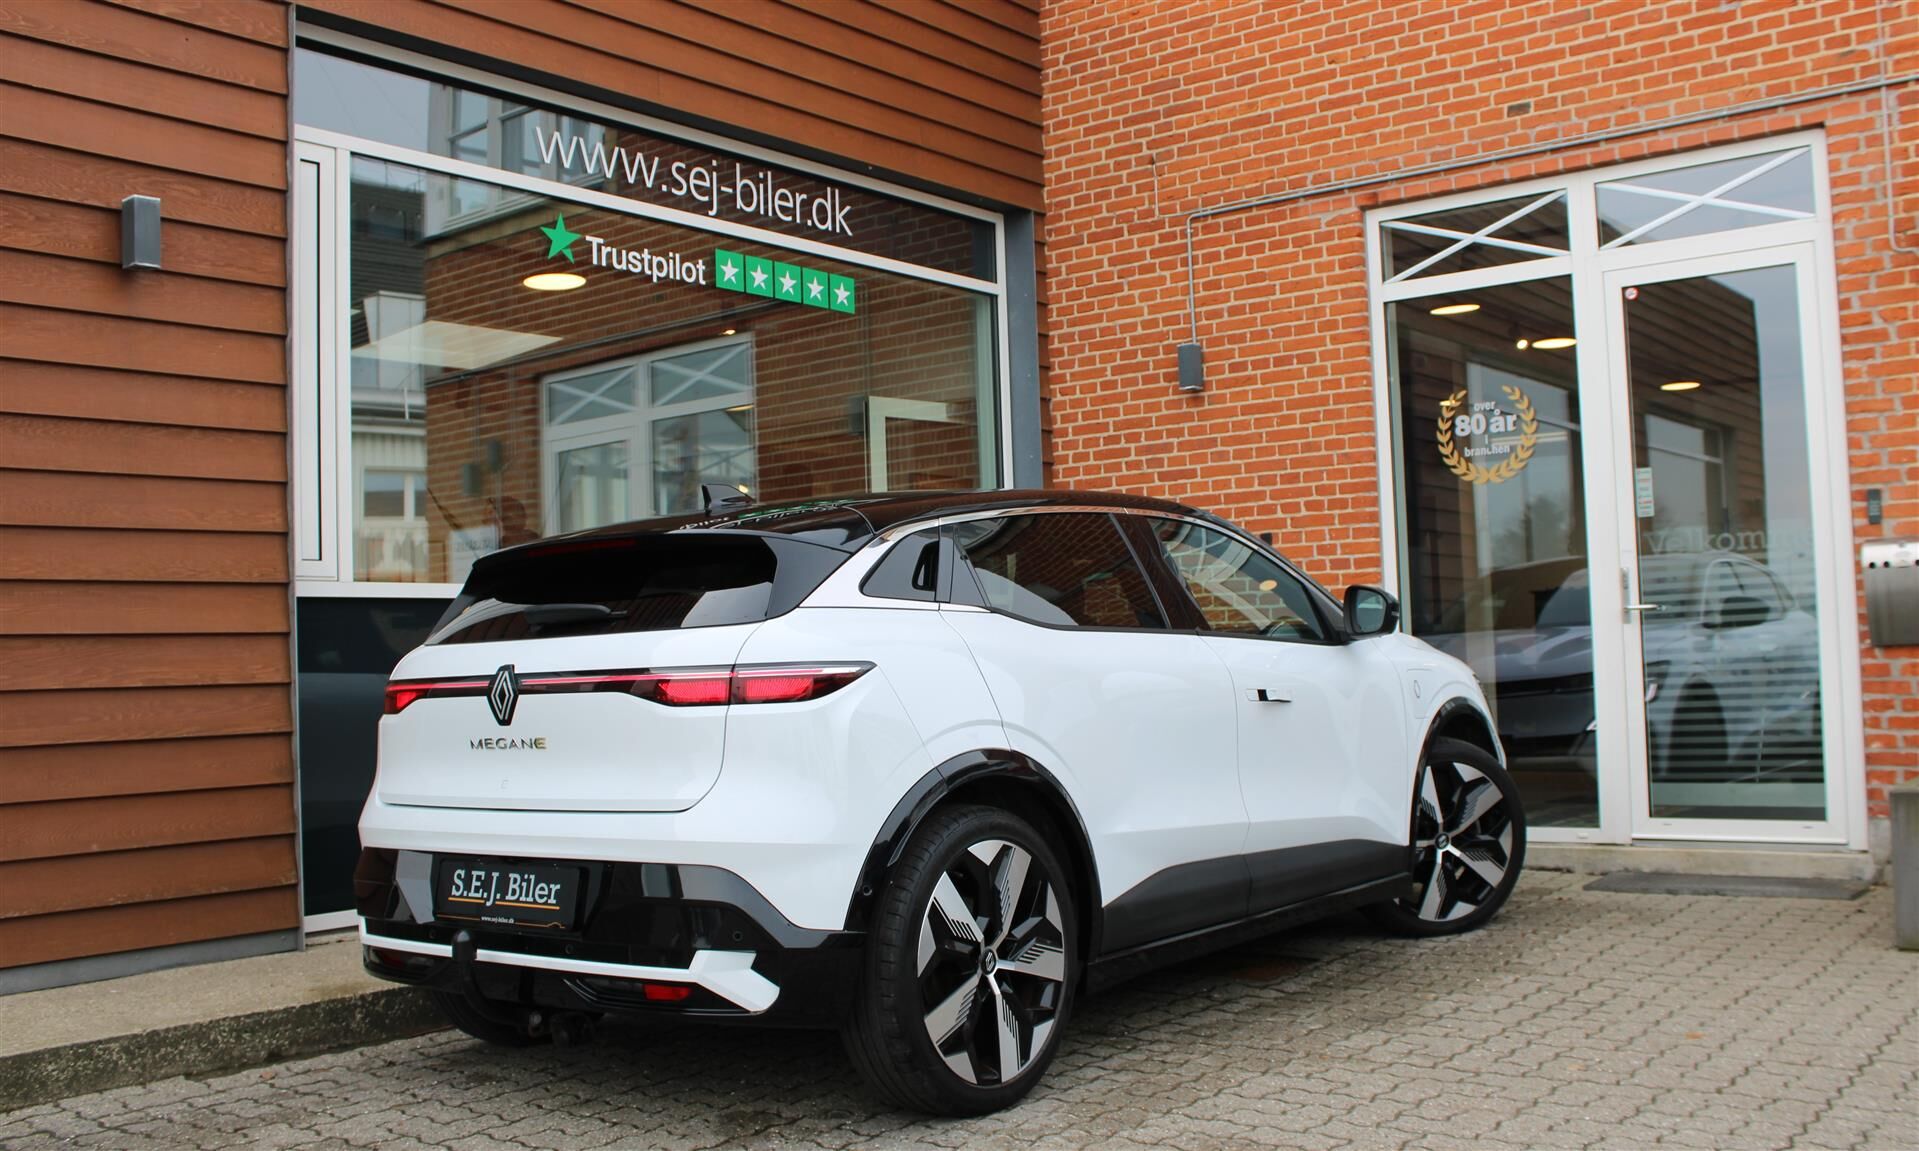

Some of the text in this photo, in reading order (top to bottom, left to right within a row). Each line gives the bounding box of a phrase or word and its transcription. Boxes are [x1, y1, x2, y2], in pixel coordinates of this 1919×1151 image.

[535, 126, 853, 237] www.sej-biler.dk
[585, 234, 706, 286] Trustpilot
[1474, 401, 1496, 411] over
[1455, 408, 1517, 436] 80 år
[1464, 445, 1510, 457] branchen
[470, 737, 547, 750] MEGANE
[451, 868, 561, 906] S.E.J. Biler
